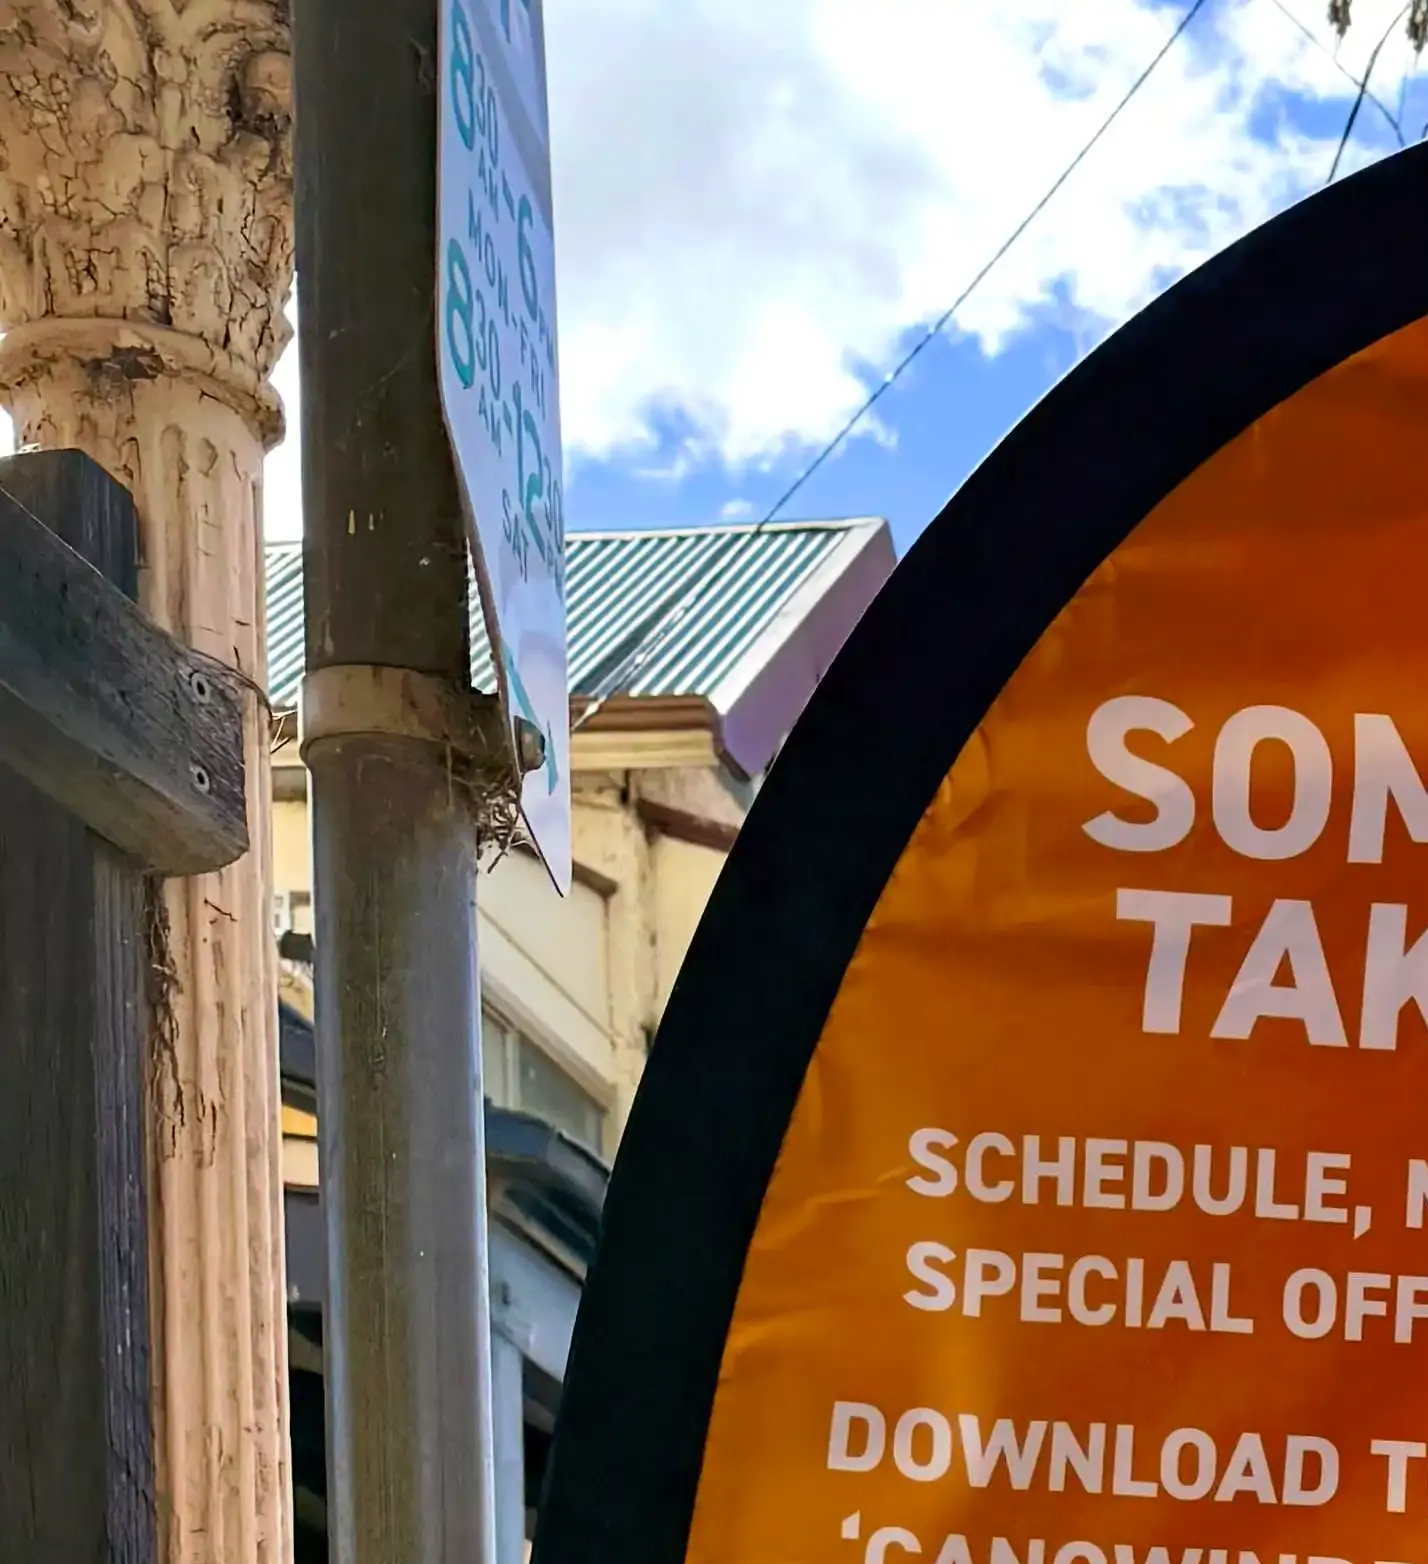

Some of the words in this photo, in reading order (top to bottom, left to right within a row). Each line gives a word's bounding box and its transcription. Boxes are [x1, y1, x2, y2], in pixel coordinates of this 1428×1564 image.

[502, 486, 529, 584] SAT
[906, 1127, 1373, 1239] SCHEDULE,
[903, 1240, 1254, 1335] SPECIAL
[826, 1400, 1341, 1508] DOWNLOAD
